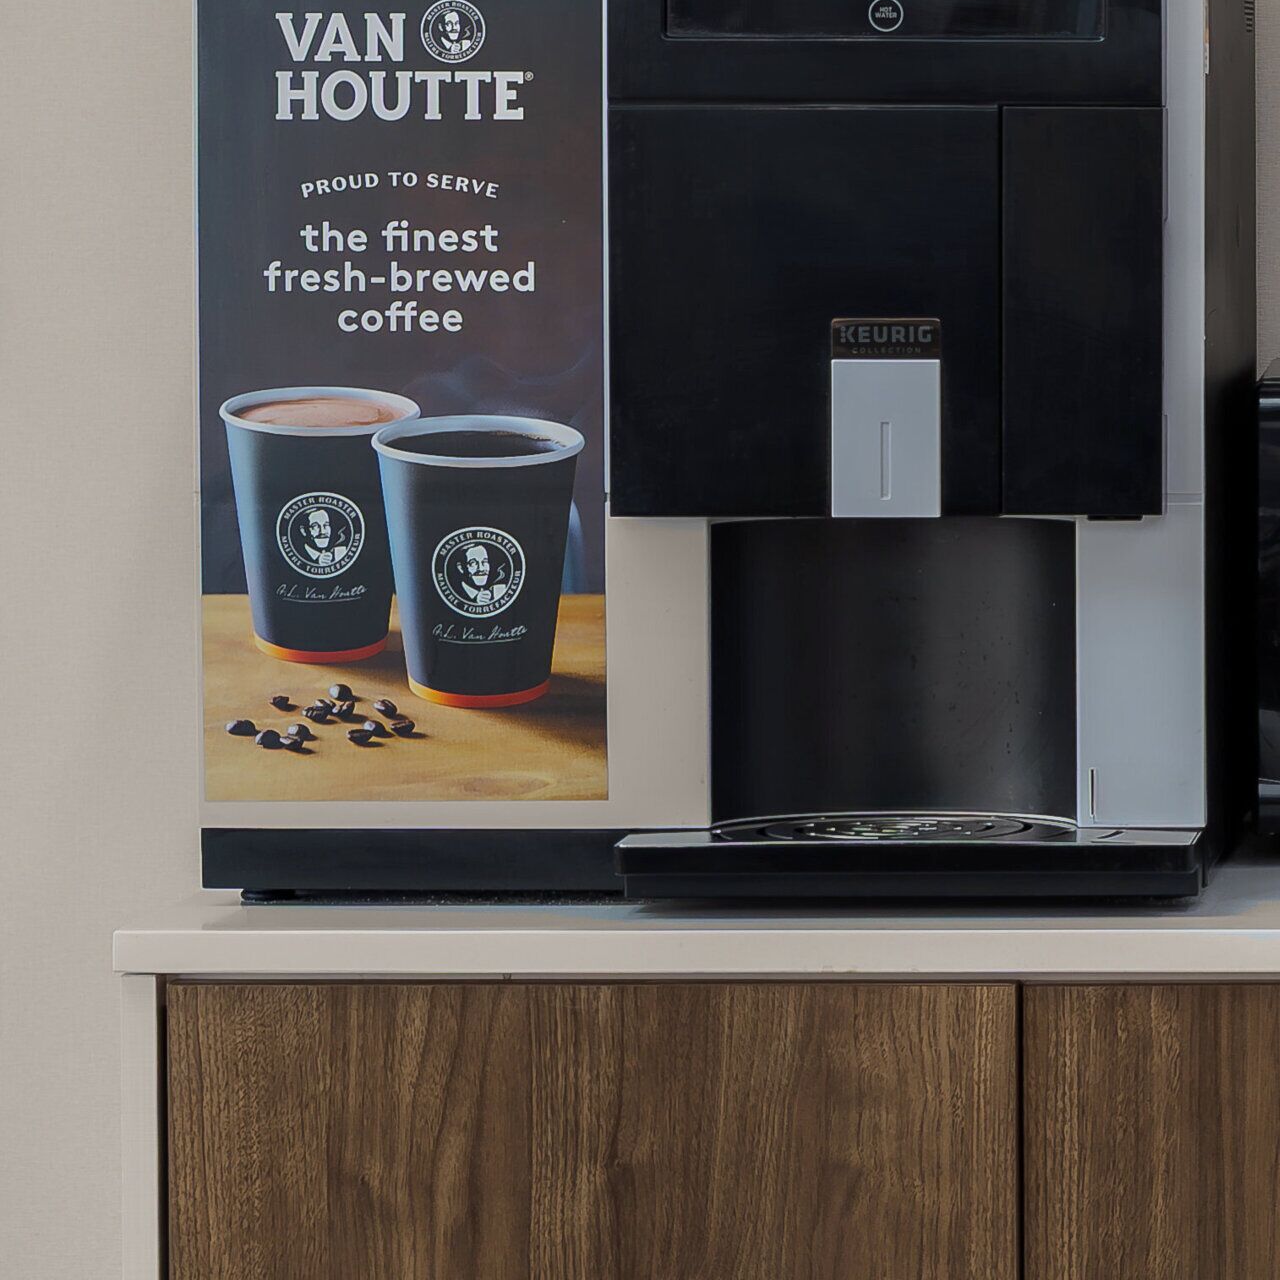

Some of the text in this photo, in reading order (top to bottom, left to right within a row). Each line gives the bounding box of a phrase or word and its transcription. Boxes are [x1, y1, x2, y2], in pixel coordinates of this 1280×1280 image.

[275, 13, 405, 62] VAN
[275, 70, 524, 120] HOUTTE
[301, 172, 499, 198] PROUD TO SERVE
[300, 221, 498, 252] the finest
[263, 261, 535, 292] fresh-brewed
[338, 301, 463, 332] coffee
[841, 326, 932, 342] KEURIG
[284, 497, 357, 519] MASTER ROASTER
[440, 532, 517, 556] MASTER ROASTER
